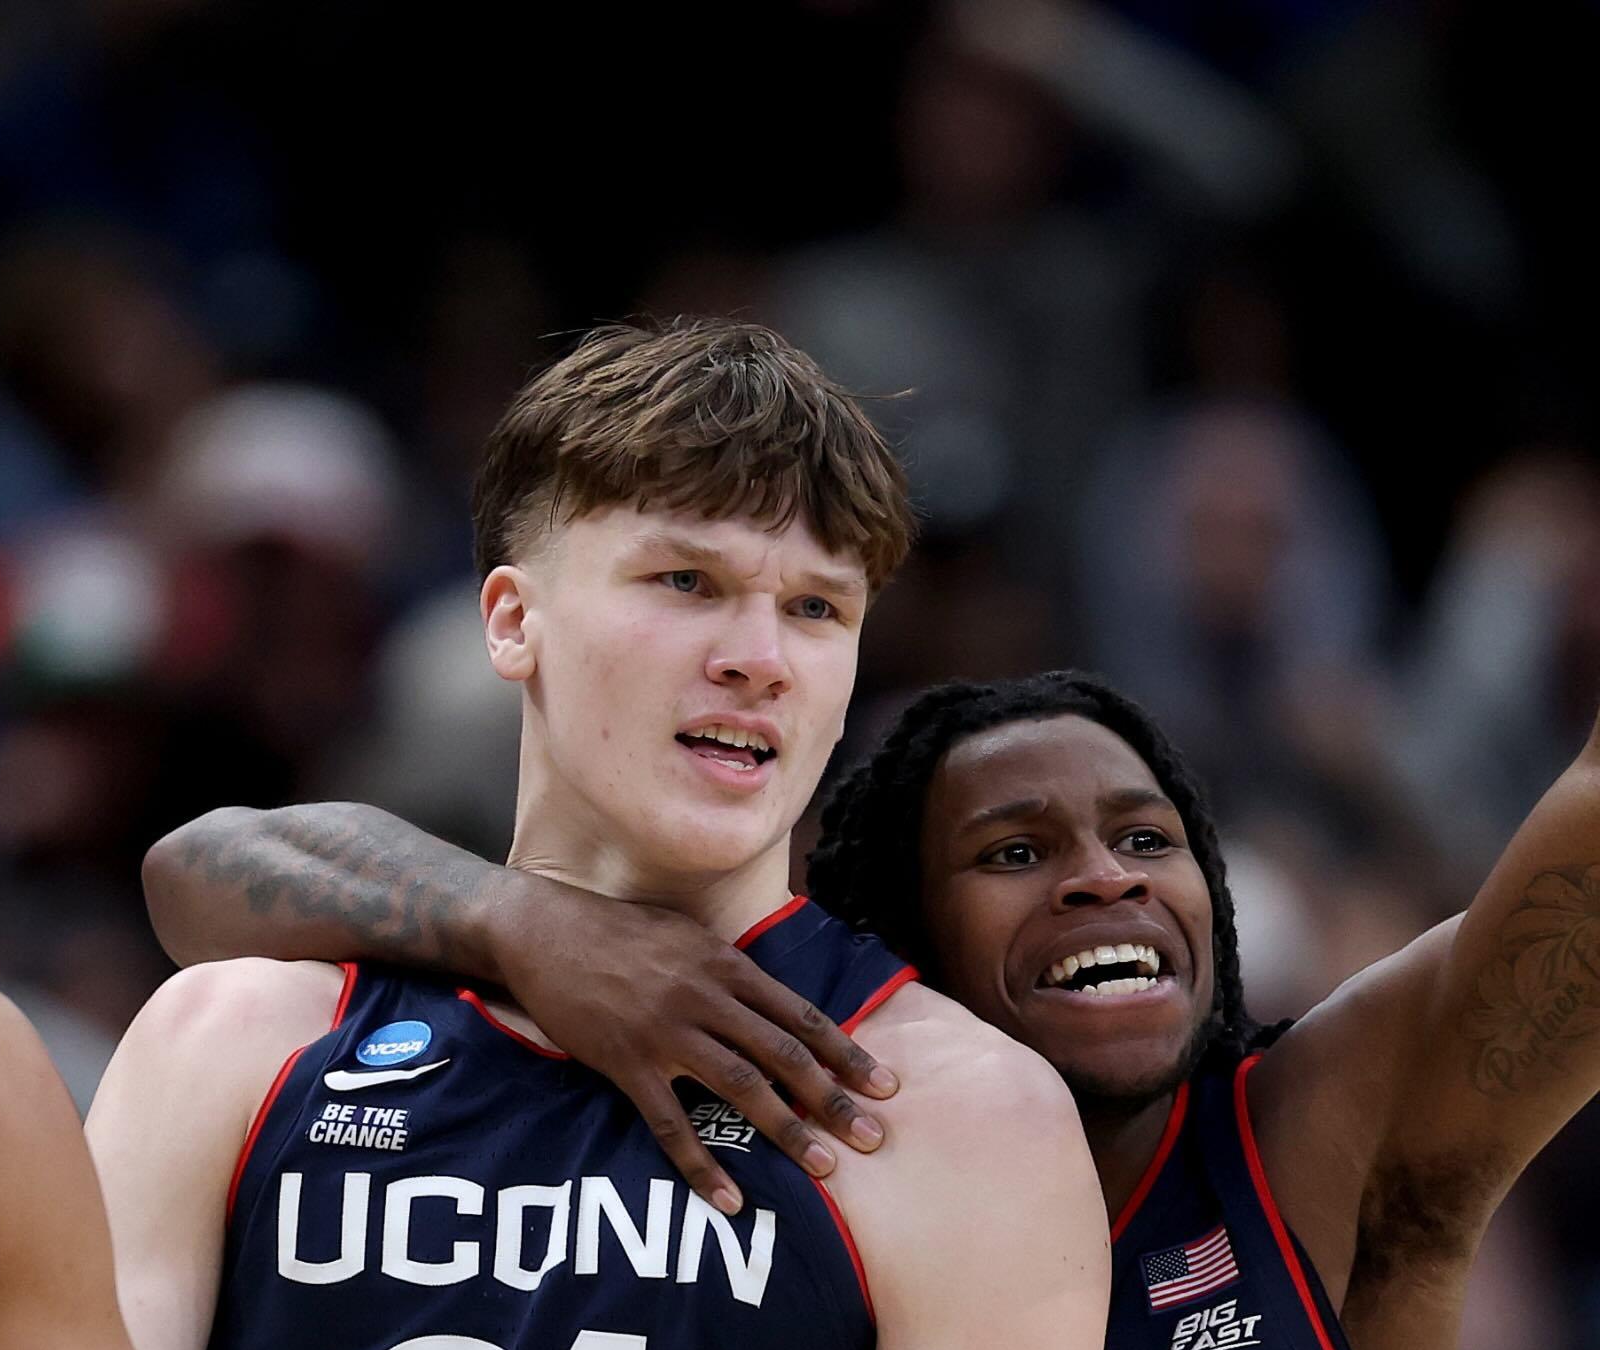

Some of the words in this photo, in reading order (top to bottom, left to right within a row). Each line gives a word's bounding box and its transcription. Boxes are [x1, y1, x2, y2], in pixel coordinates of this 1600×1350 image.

[364, 1040, 424, 1055] NCAA
[322, 1103, 357, 1122] BE
[362, 1106, 408, 1127] THE
[309, 1120, 408, 1151] CHANGE
[691, 1121, 756, 1144] AST
[278, 1172, 776, 1309] UCONN
[1172, 1299, 1238, 1340] BIG
